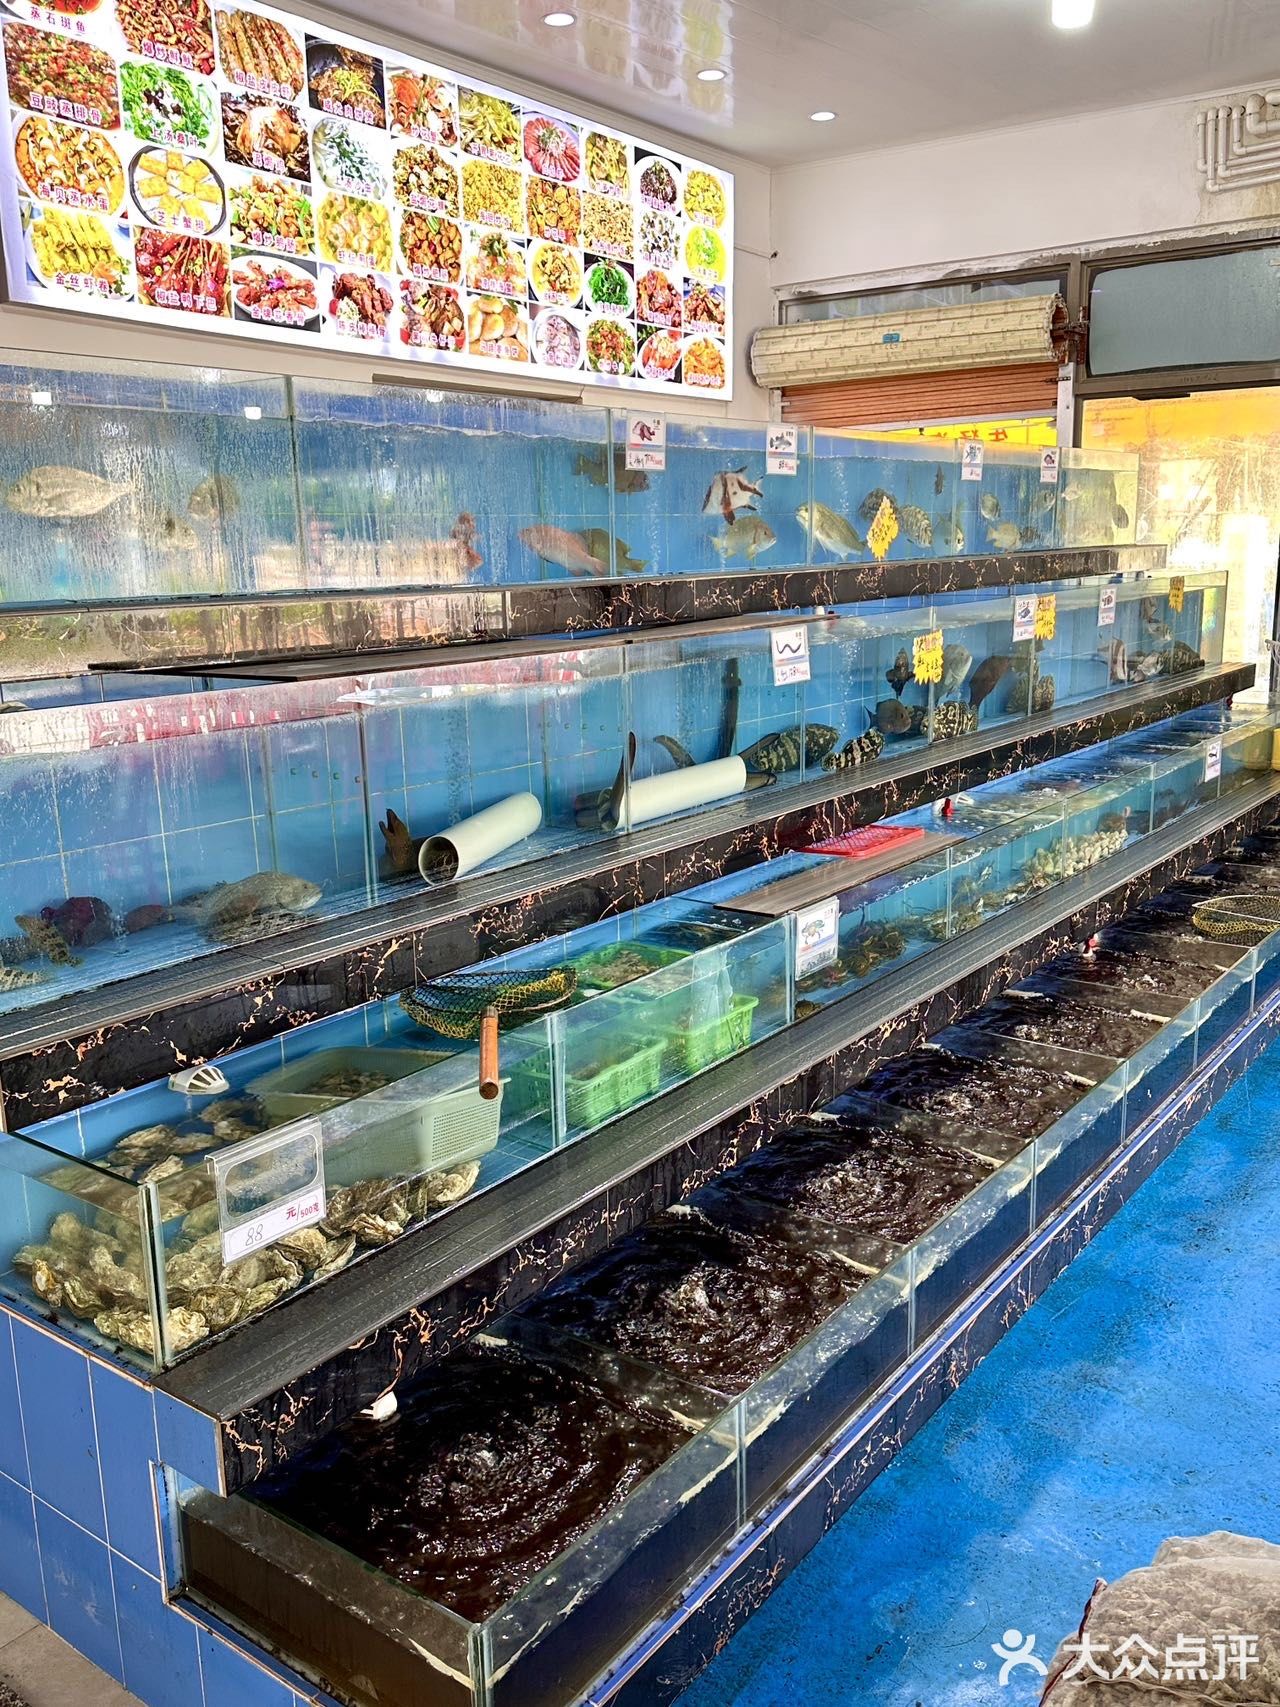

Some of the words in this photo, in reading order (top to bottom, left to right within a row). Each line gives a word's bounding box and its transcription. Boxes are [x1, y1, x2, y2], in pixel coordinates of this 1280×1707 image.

[30, 6, 86, 32] 蒸石斑鱼
[30, 93, 102, 125] 豆豉蒸排骨
[152, 127, 199, 148] 上汤桑叶
[39, 183, 109, 212] 海贝蒸水蛋
[55, 272, 109, 294] 金丝虾卷
[156, 288, 217, 311] 椒盐鸭下巴
[245, 1223, 264, 1247] 88
[285, 1200, 320, 1221] 元/500克
